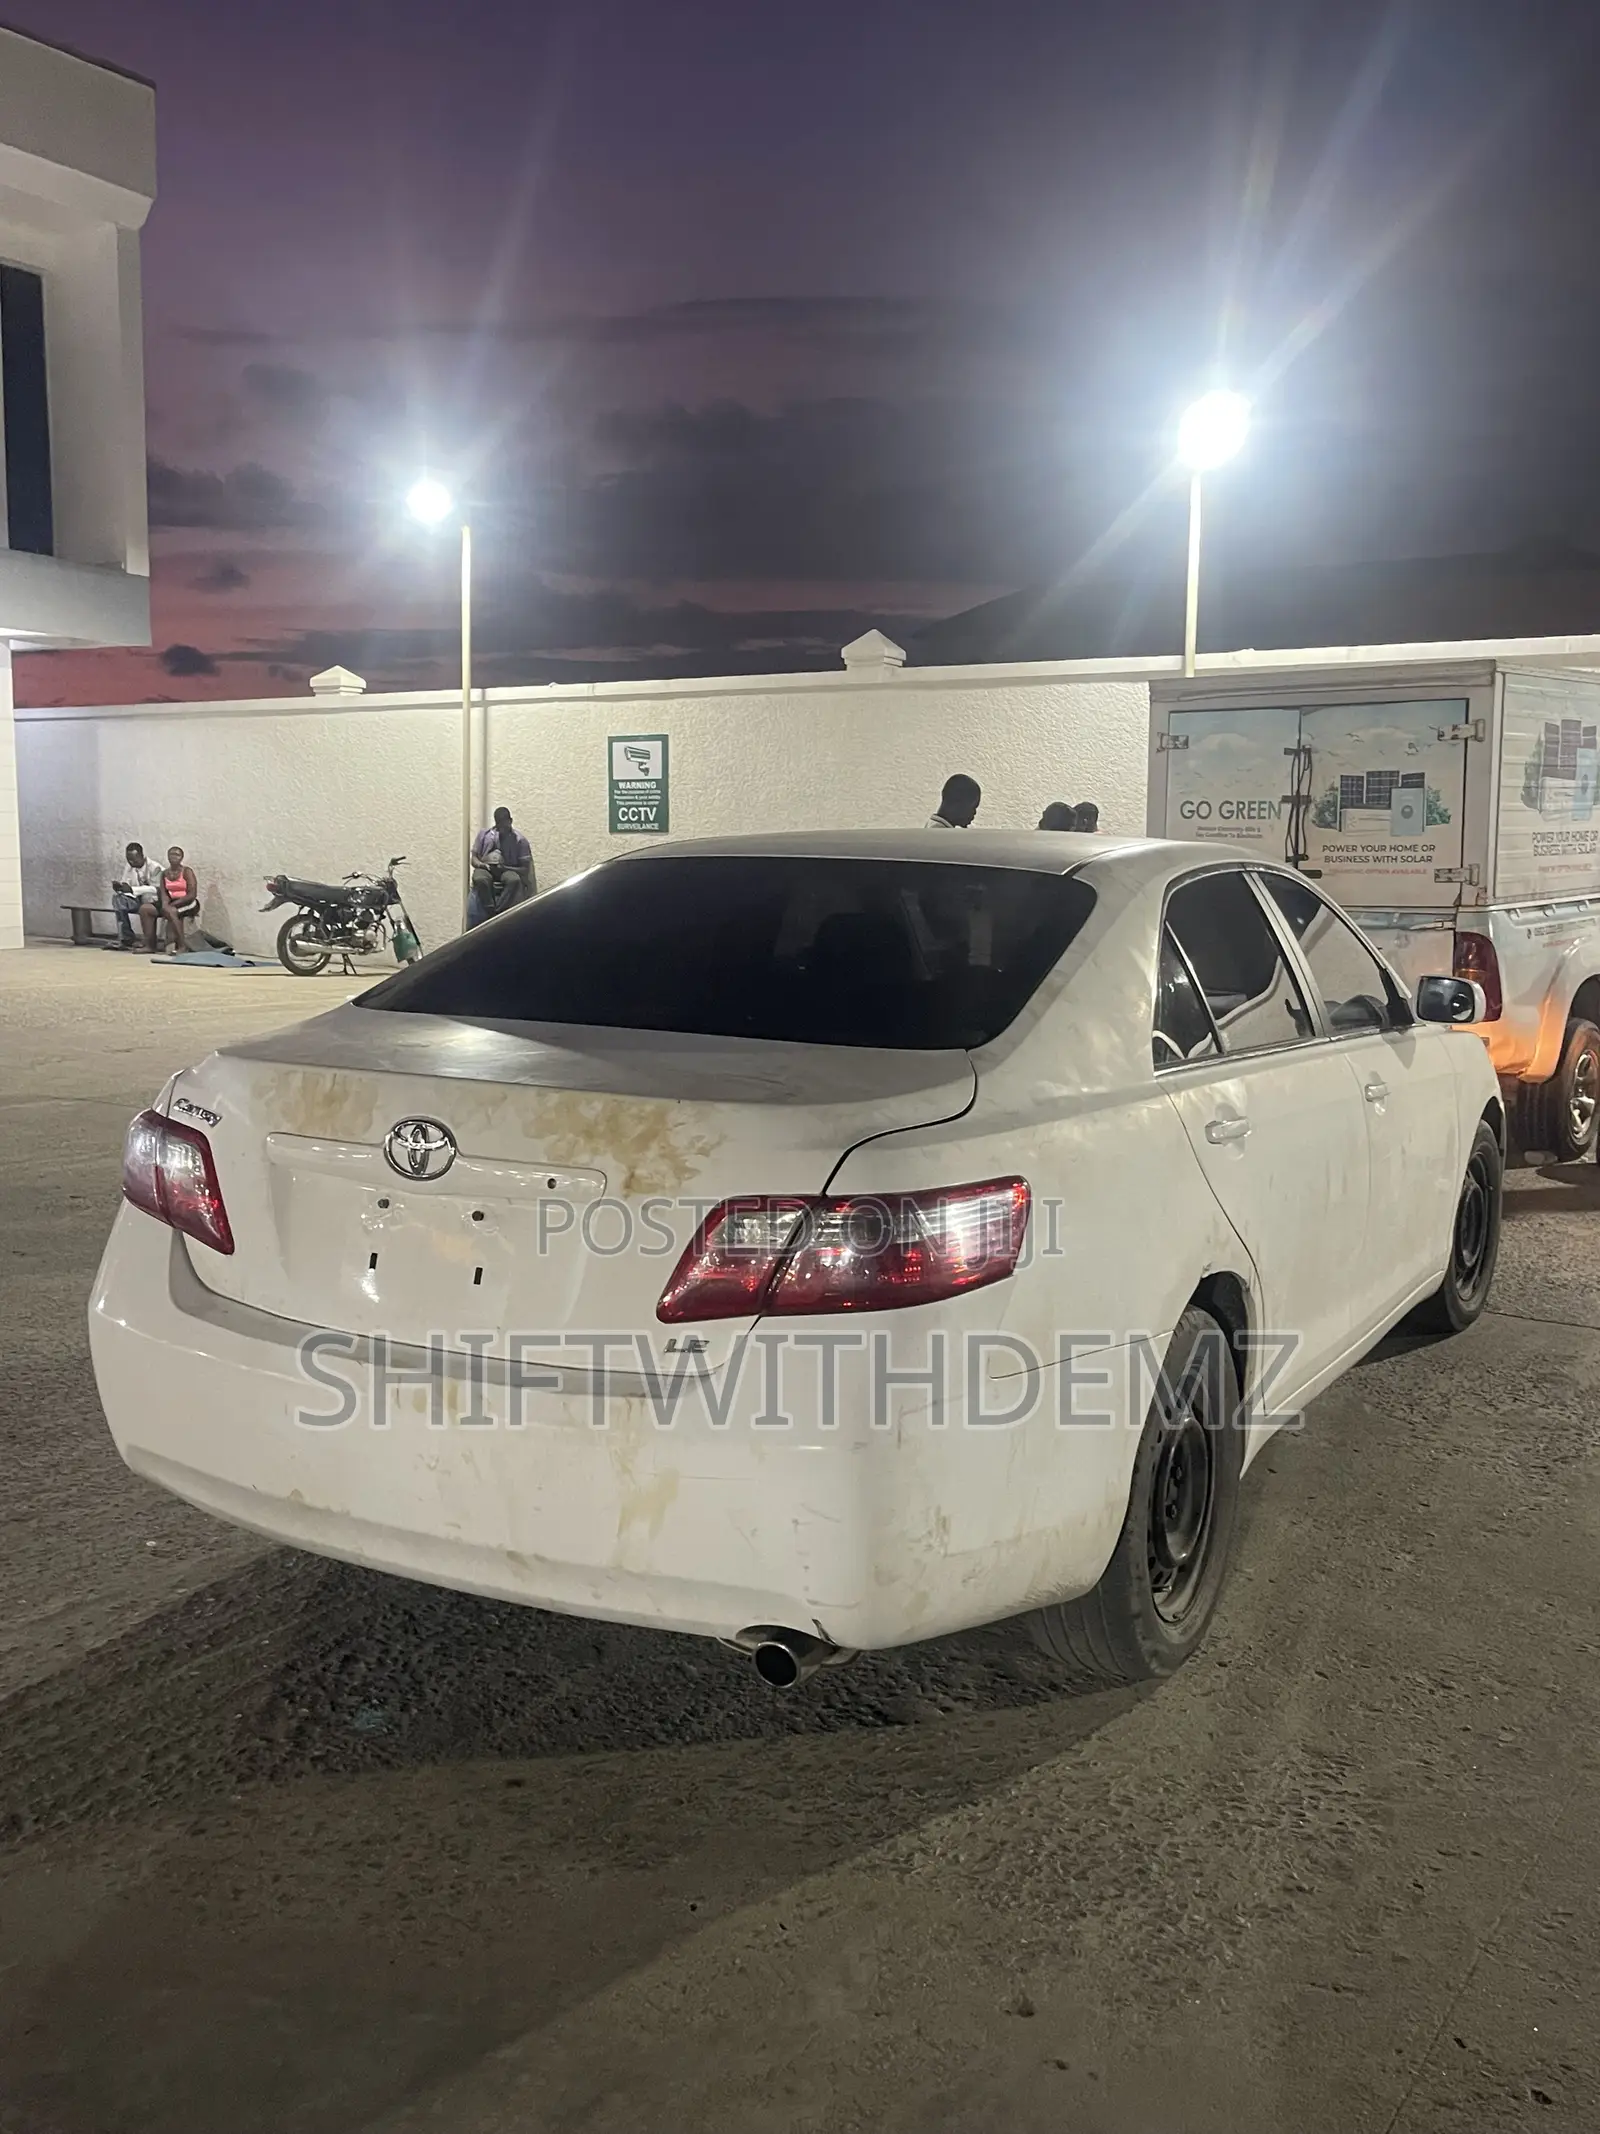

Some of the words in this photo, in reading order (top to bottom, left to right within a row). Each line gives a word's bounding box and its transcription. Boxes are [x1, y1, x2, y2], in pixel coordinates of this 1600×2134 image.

[618, 781, 657, 789] WARNING
[618, 806, 657, 821] CCTV
[1180, 800, 1212, 820] GO
[1218, 800, 1282, 820] GREEN
[1321, 844, 1358, 853] POWER
[1360, 844, 1387, 853] YOUR
[1389, 844, 1419, 853] HOME
[1420, 844, 1436, 852] OR
[1324, 855, 1371, 864] BUSINESS
[1372, 855, 1399, 864] WITH
[1400, 855, 1433, 863] SOLAR
[664, 1338, 710, 1353] LE
